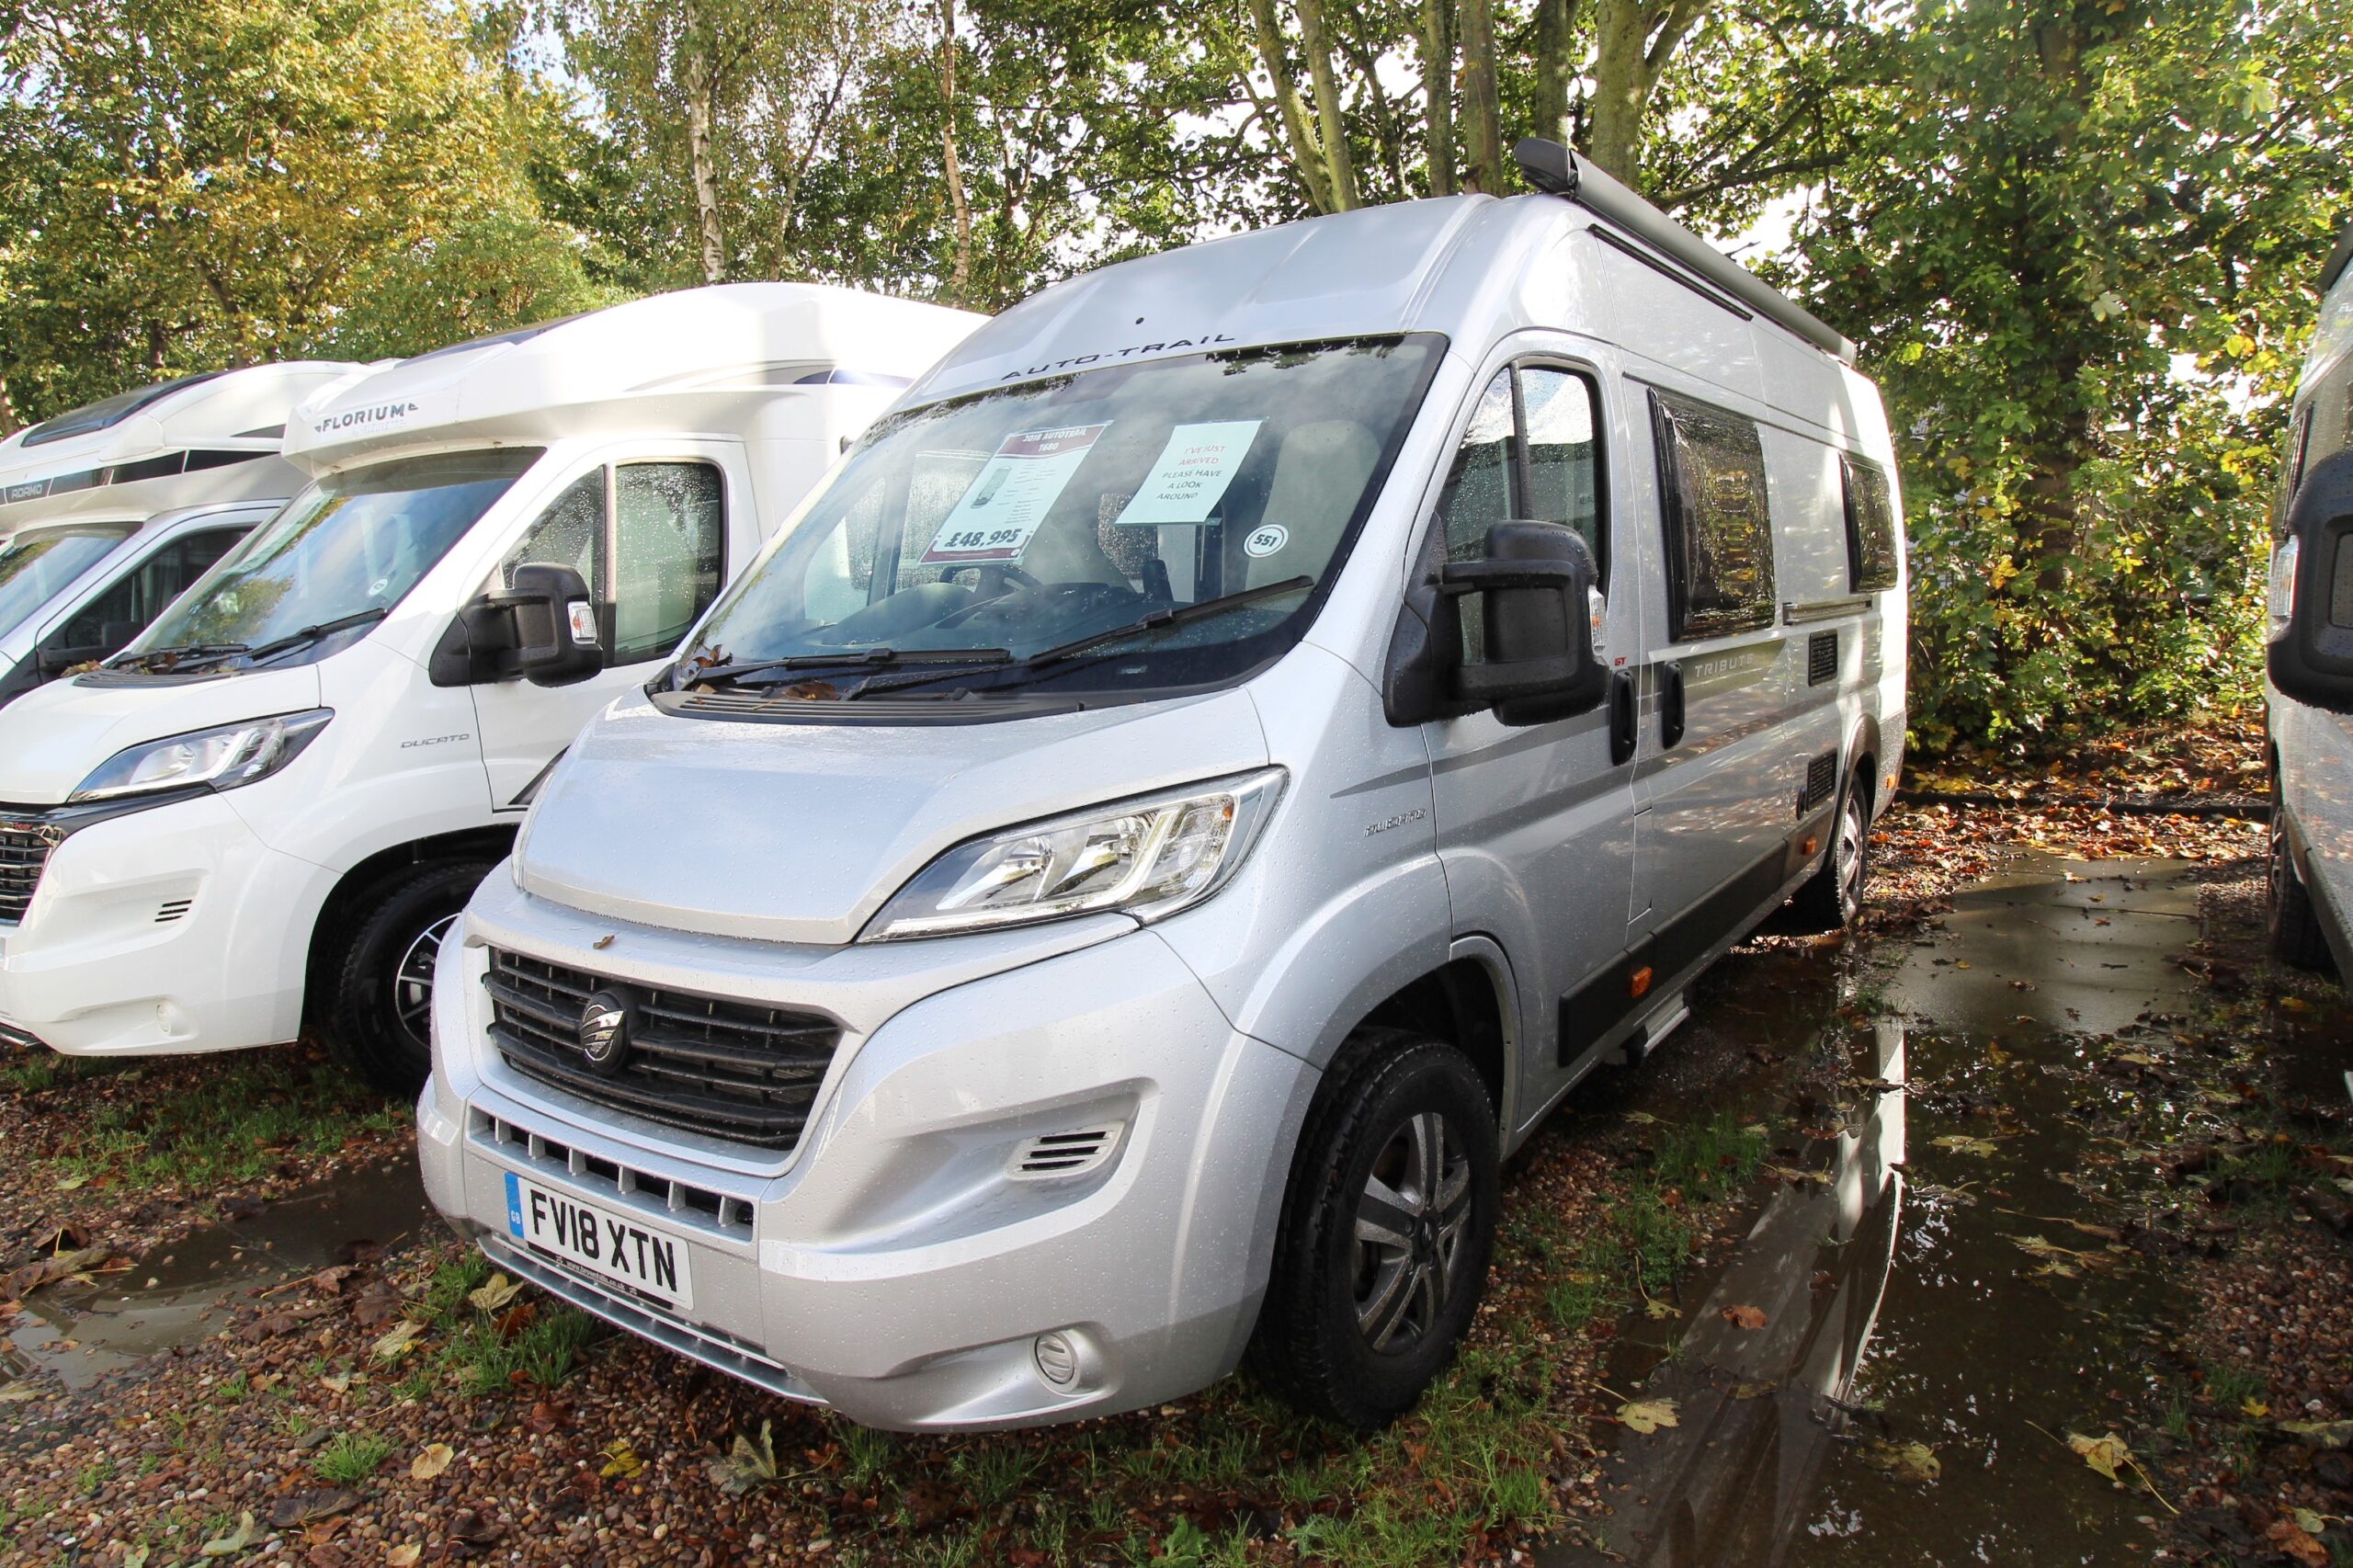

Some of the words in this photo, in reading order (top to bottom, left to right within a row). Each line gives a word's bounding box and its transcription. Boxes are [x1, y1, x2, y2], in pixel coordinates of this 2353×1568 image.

[1001, 334, 1235, 381] AUTO-TRAIL
[322, 403, 405, 433] FLORIUM
[1022, 433, 1042, 443] 2018
[1042, 427, 1087, 440] AUTOTRAIL
[1177, 457, 1220, 466] ARRIVED
[1163, 470, 1194, 478] PLEASE
[11, 483, 43, 499] ADAMO
[1176, 481, 1202, 489] LOOK
[1156, 492, 1199, 500] AROUND
[944, 528, 1022, 548] £48,995
[1253, 533, 1279, 548] 551
[1694, 653, 1755, 678] TRIBUTE
[401, 733, 470, 748] DUCATO
[510, 1210, 520, 1224] GB
[530, 1188, 600, 1260] FV18
[607, 1219, 677, 1293] XTN
